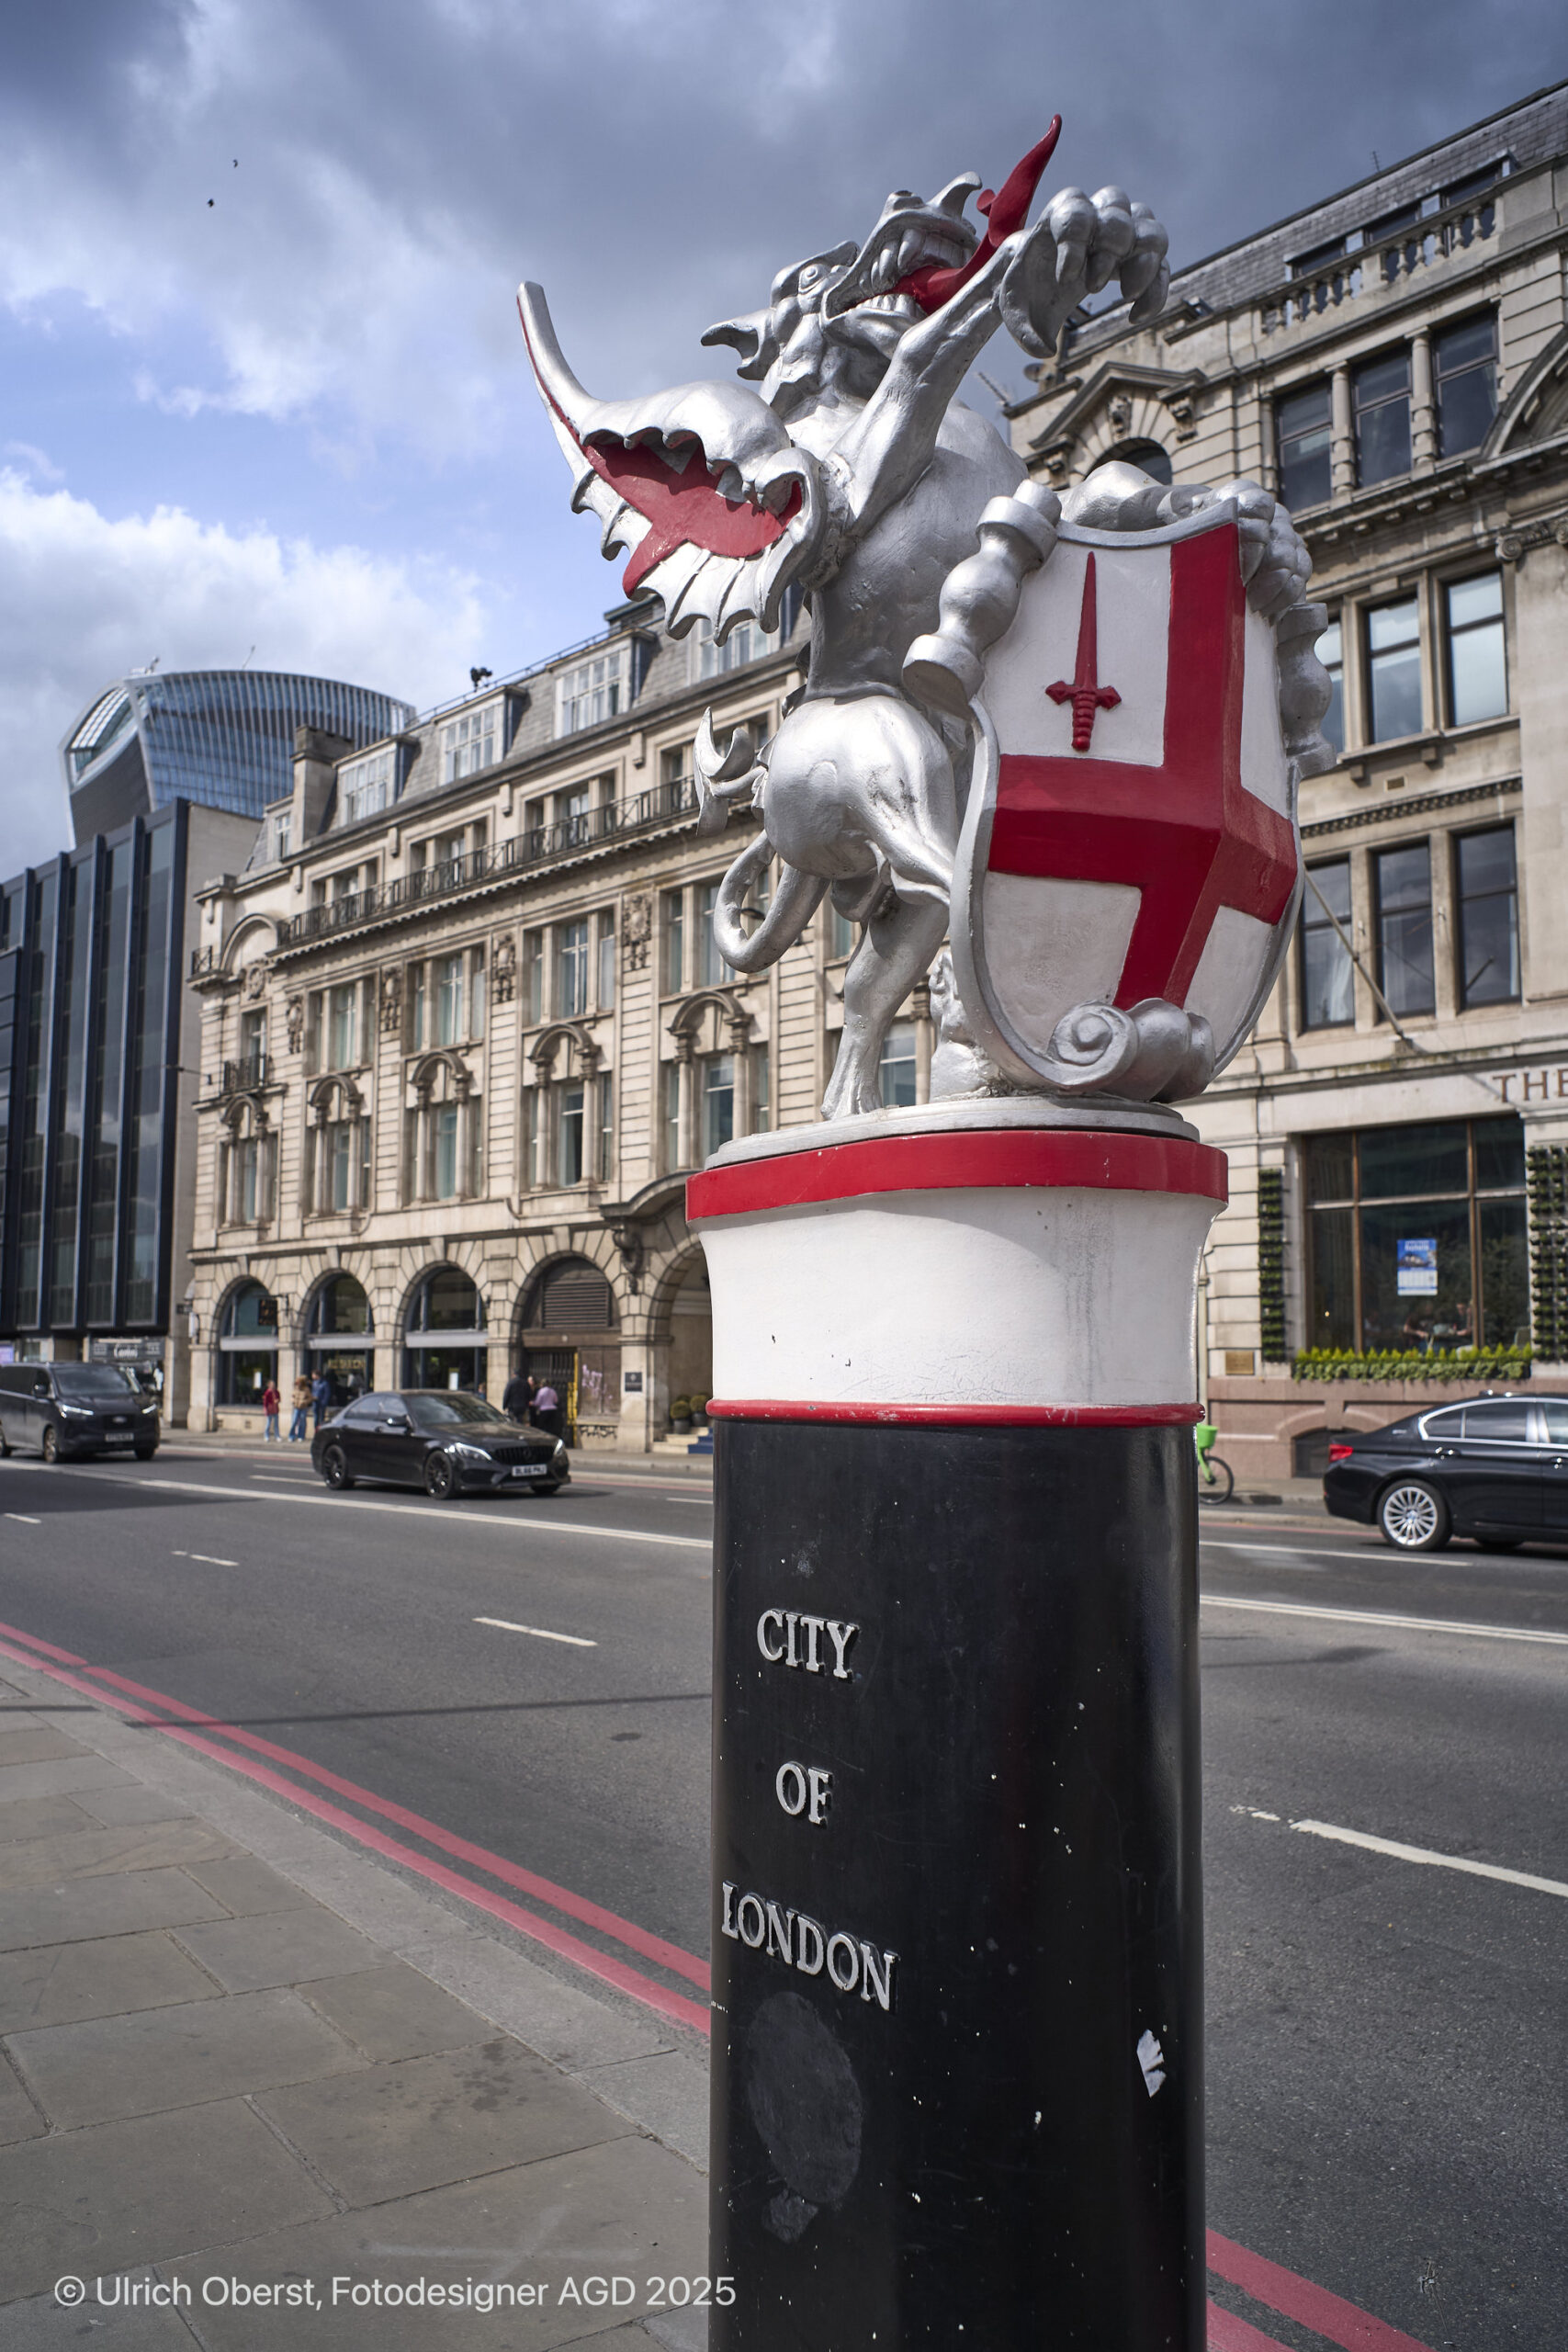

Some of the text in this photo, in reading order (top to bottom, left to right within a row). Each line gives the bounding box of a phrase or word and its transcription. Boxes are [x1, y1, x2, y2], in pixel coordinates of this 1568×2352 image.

[1492, 1069, 1568, 1103] THE
[756, 1608, 860, 1679] CITY
[775, 1760, 832, 1826] OF
[721, 1881, 898, 2012] LONDON
